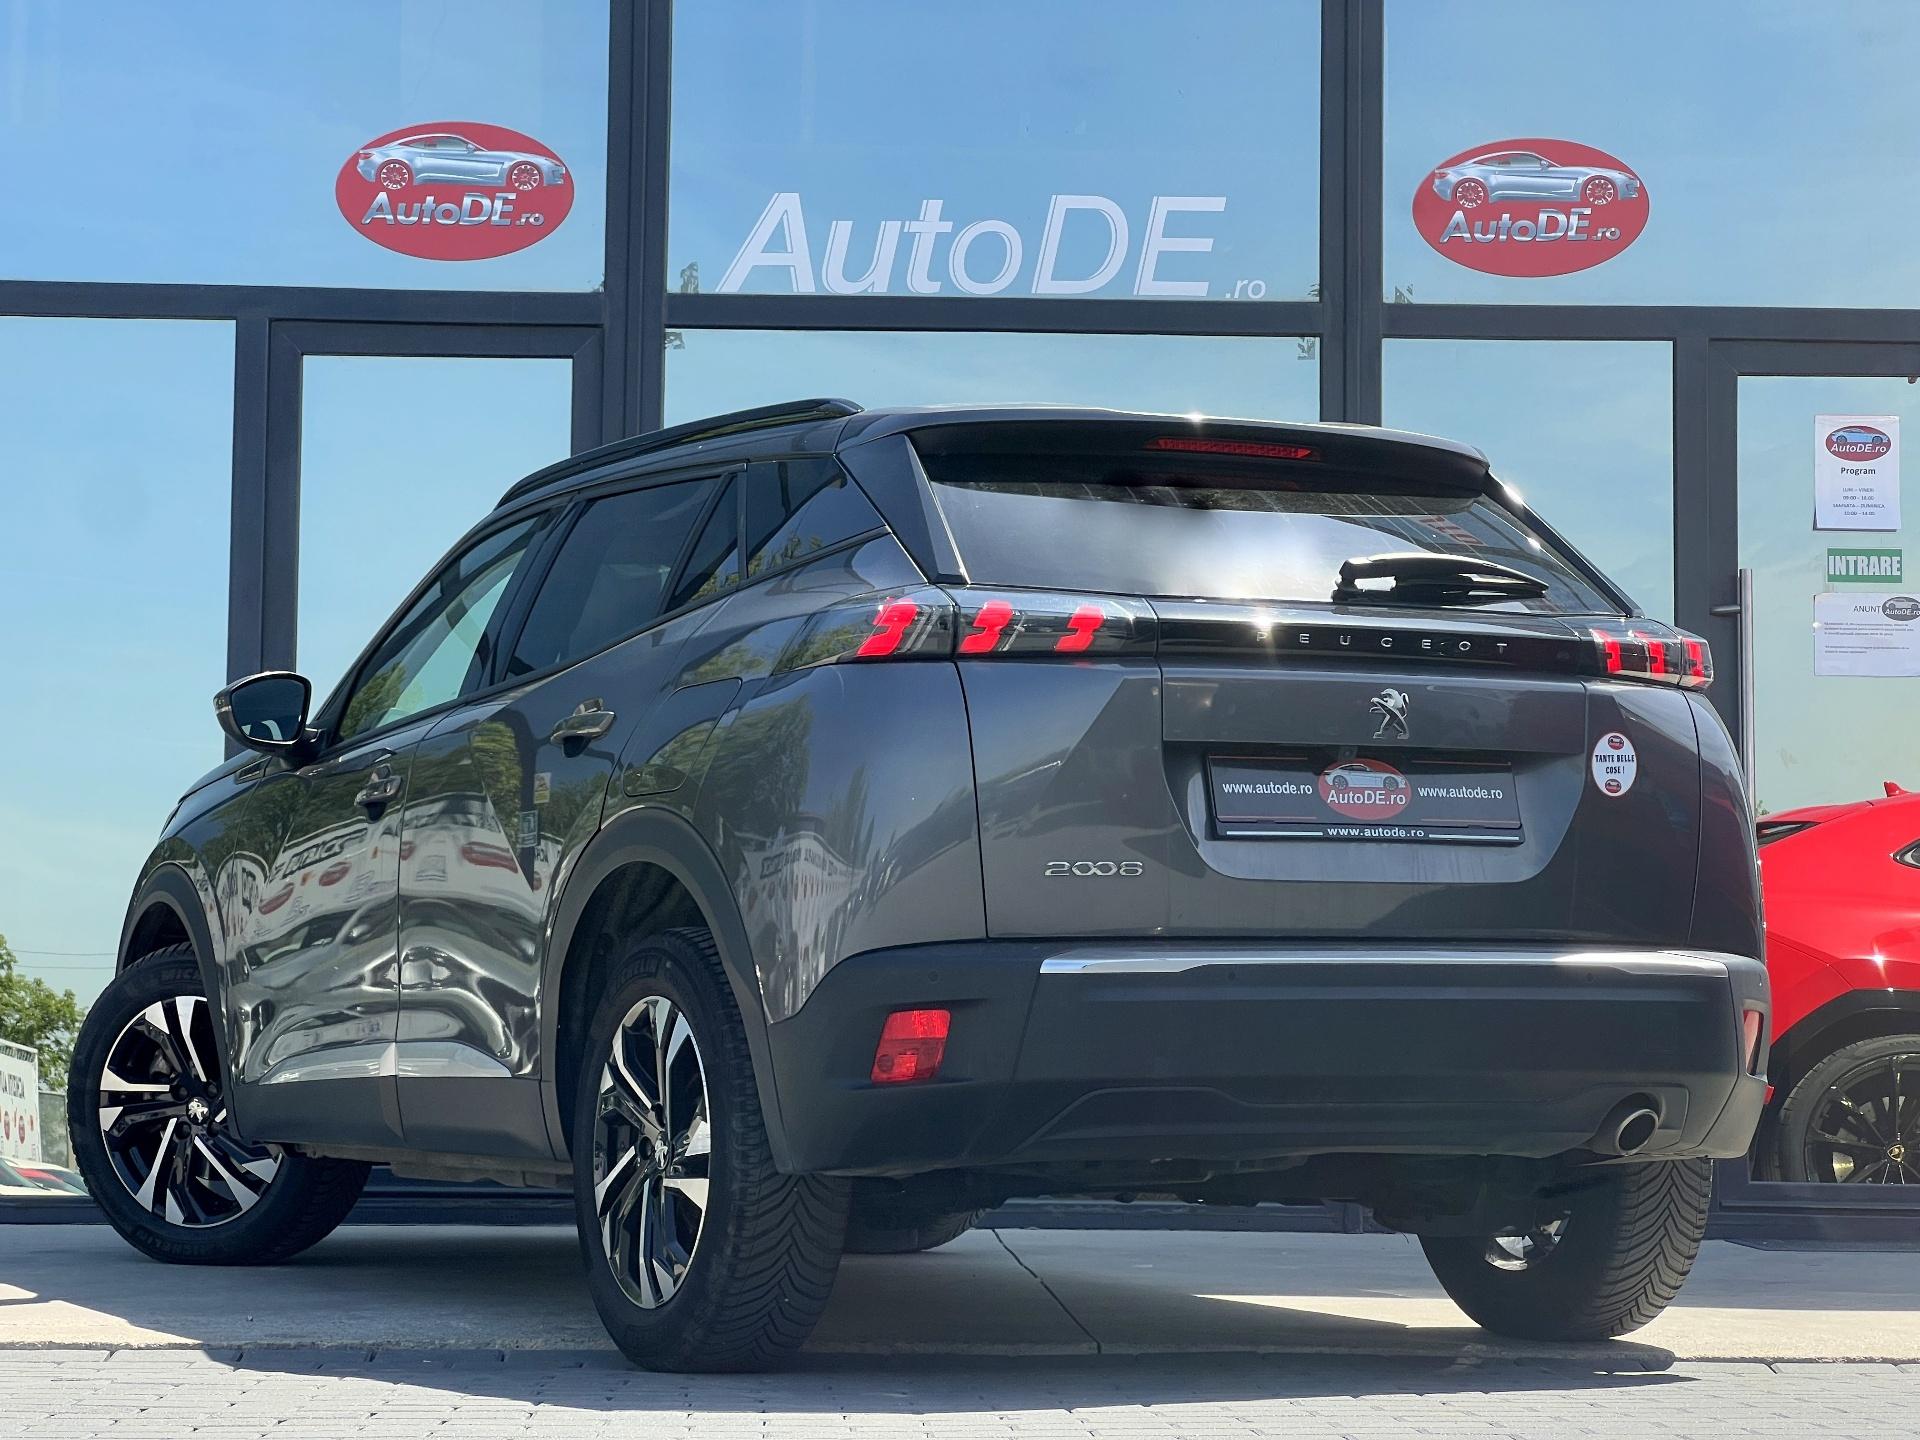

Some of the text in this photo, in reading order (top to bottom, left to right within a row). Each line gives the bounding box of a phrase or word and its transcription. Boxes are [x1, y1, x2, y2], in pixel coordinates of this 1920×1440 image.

[1830, 443, 1887, 453] AutoDE.ro
[1840, 467, 1876, 476] Program
[1828, 555, 1901, 576] INTRARE
[1256, 632, 1508, 655] PEUGEOT
[1595, 754, 1635, 763] TANTE BELLE
[1605, 766, 1621, 774] COSE
[1222, 781, 1313, 796] www.autode.ro
[1417, 785, 1504, 800] www.autode.ro
[1327, 789, 1407, 806] AutoDE.ro
[1327, 827, 1425, 838] www.autode.ro
[1044, 861, 1143, 876] 2008
